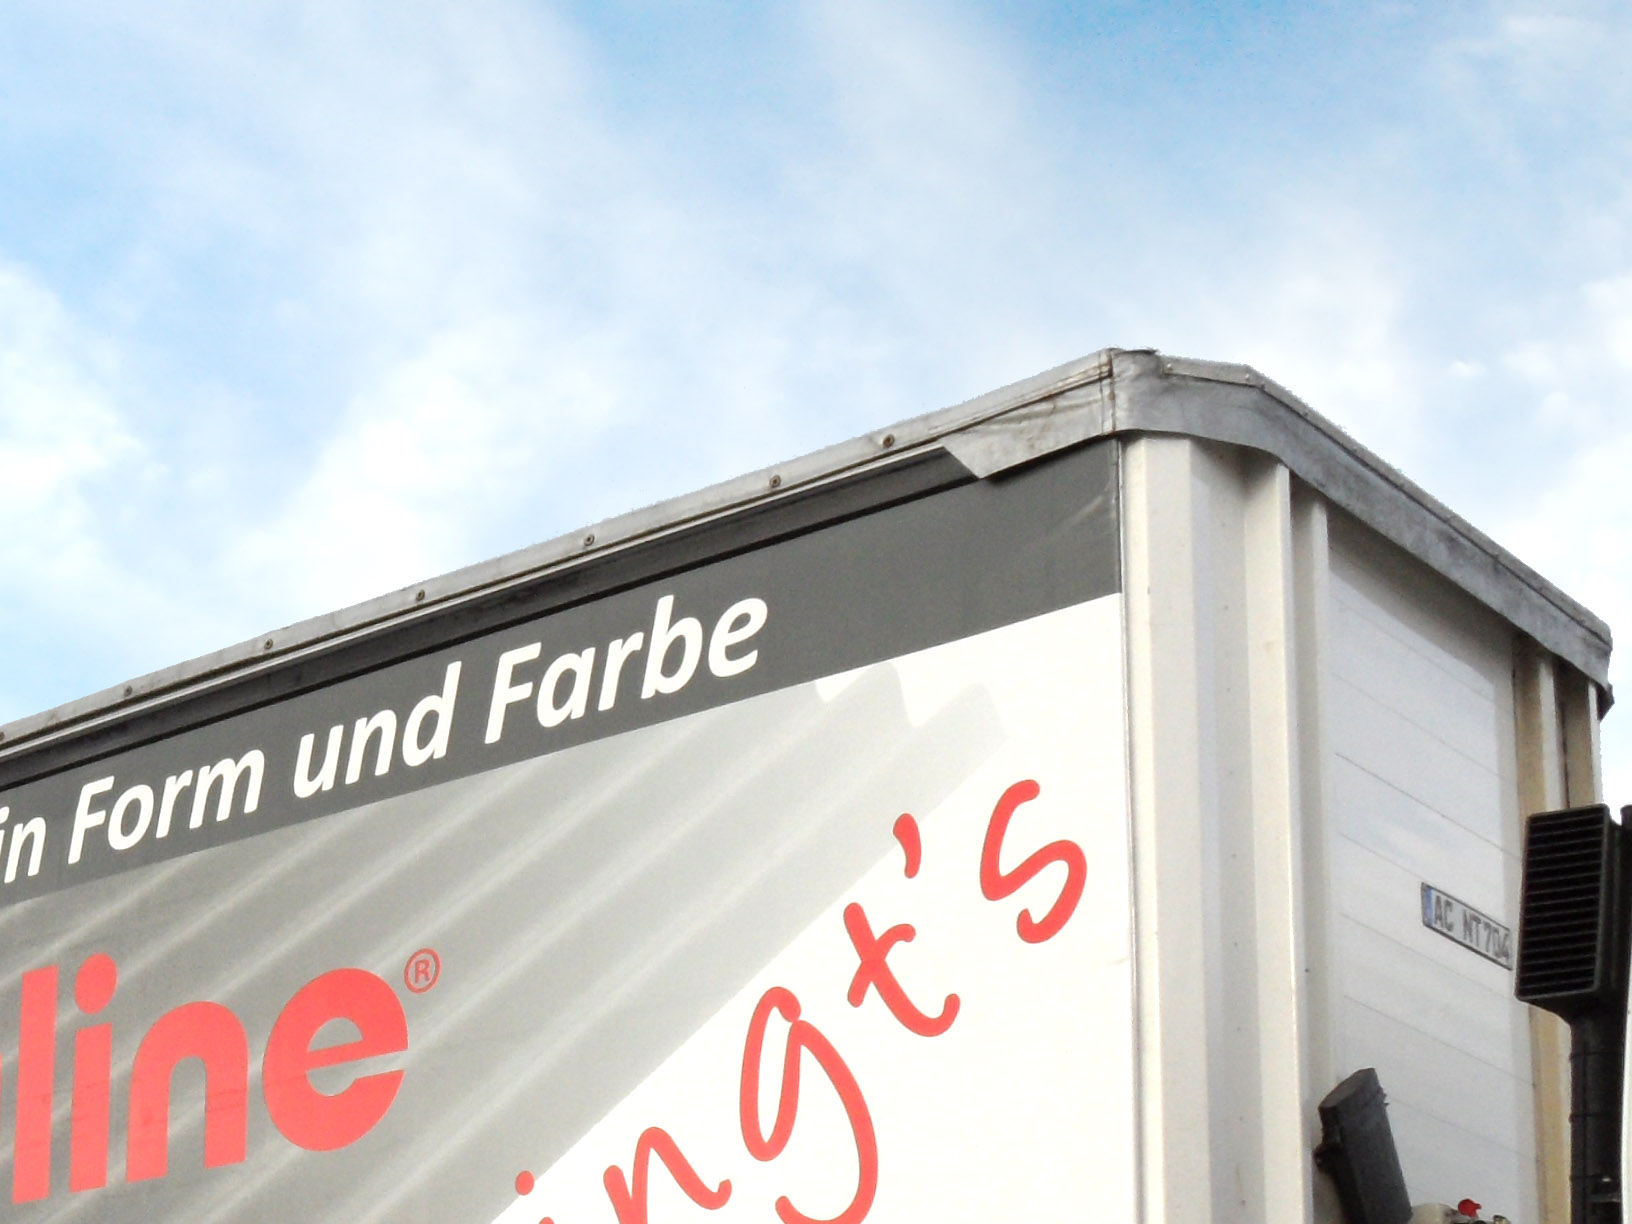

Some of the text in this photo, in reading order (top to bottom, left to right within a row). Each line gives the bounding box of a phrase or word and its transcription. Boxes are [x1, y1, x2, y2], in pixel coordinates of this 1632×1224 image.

[67, 749, 265, 865] Form
[292, 660, 462, 799] und
[483, 597, 768, 745] Farbe
